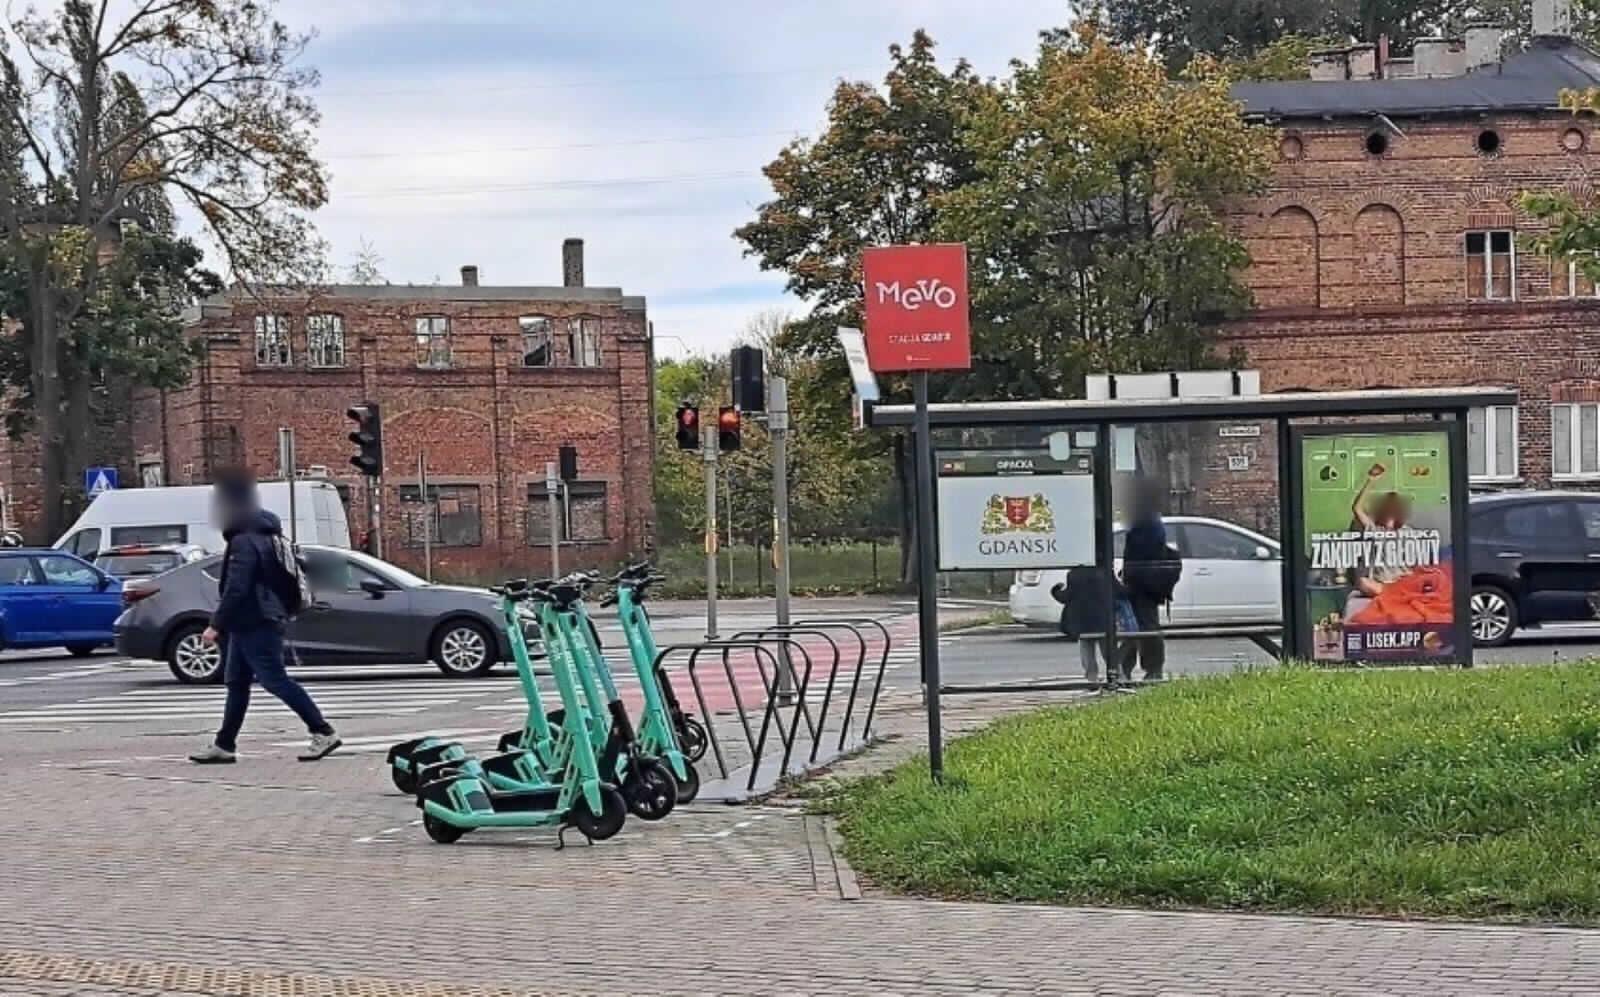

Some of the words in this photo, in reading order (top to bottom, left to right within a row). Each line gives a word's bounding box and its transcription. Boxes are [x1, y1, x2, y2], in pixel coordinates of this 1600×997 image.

[997, 459, 1033, 469] OPACKA
[1311, 532, 1361, 541] SKLEP
[1363, 531, 1397, 539] POD
[979, 536, 1057, 556] GDAŃSK
[1311, 540, 1372, 569] ZAKUPY
[1374, 539, 1385, 567] Z
[1385, 538, 1440, 567] GŁOWY
[1366, 631, 1421, 649] LISEK.APP
